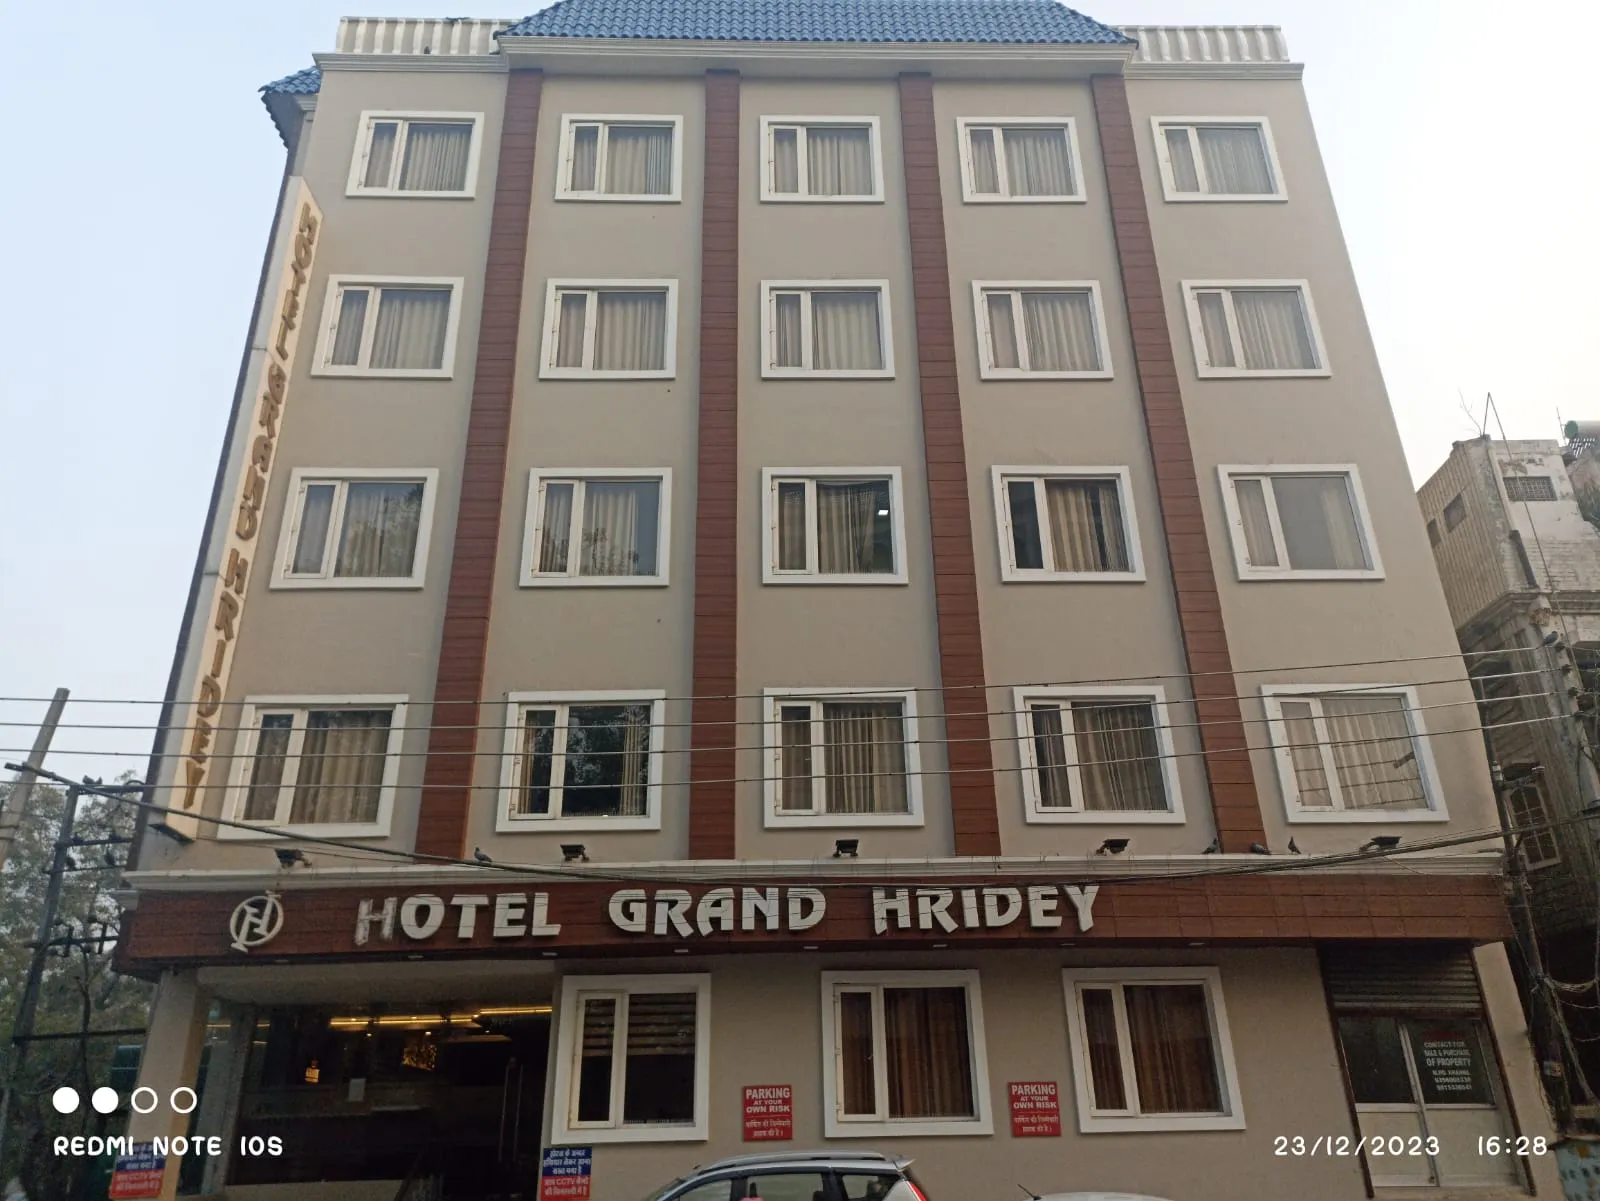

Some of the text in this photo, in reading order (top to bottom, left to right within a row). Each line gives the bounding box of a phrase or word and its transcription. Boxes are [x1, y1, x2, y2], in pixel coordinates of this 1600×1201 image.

[183, 202, 318, 810] HOTEL GRAND HRIDEY
[354, 884, 1100, 947] HOTEL GRAND HRIDEY
[1436, 1058, 1471, 1066] PROPERTY
[745, 1087, 791, 1099] PARKING
[1011, 1084, 1056, 1095] PARKING
